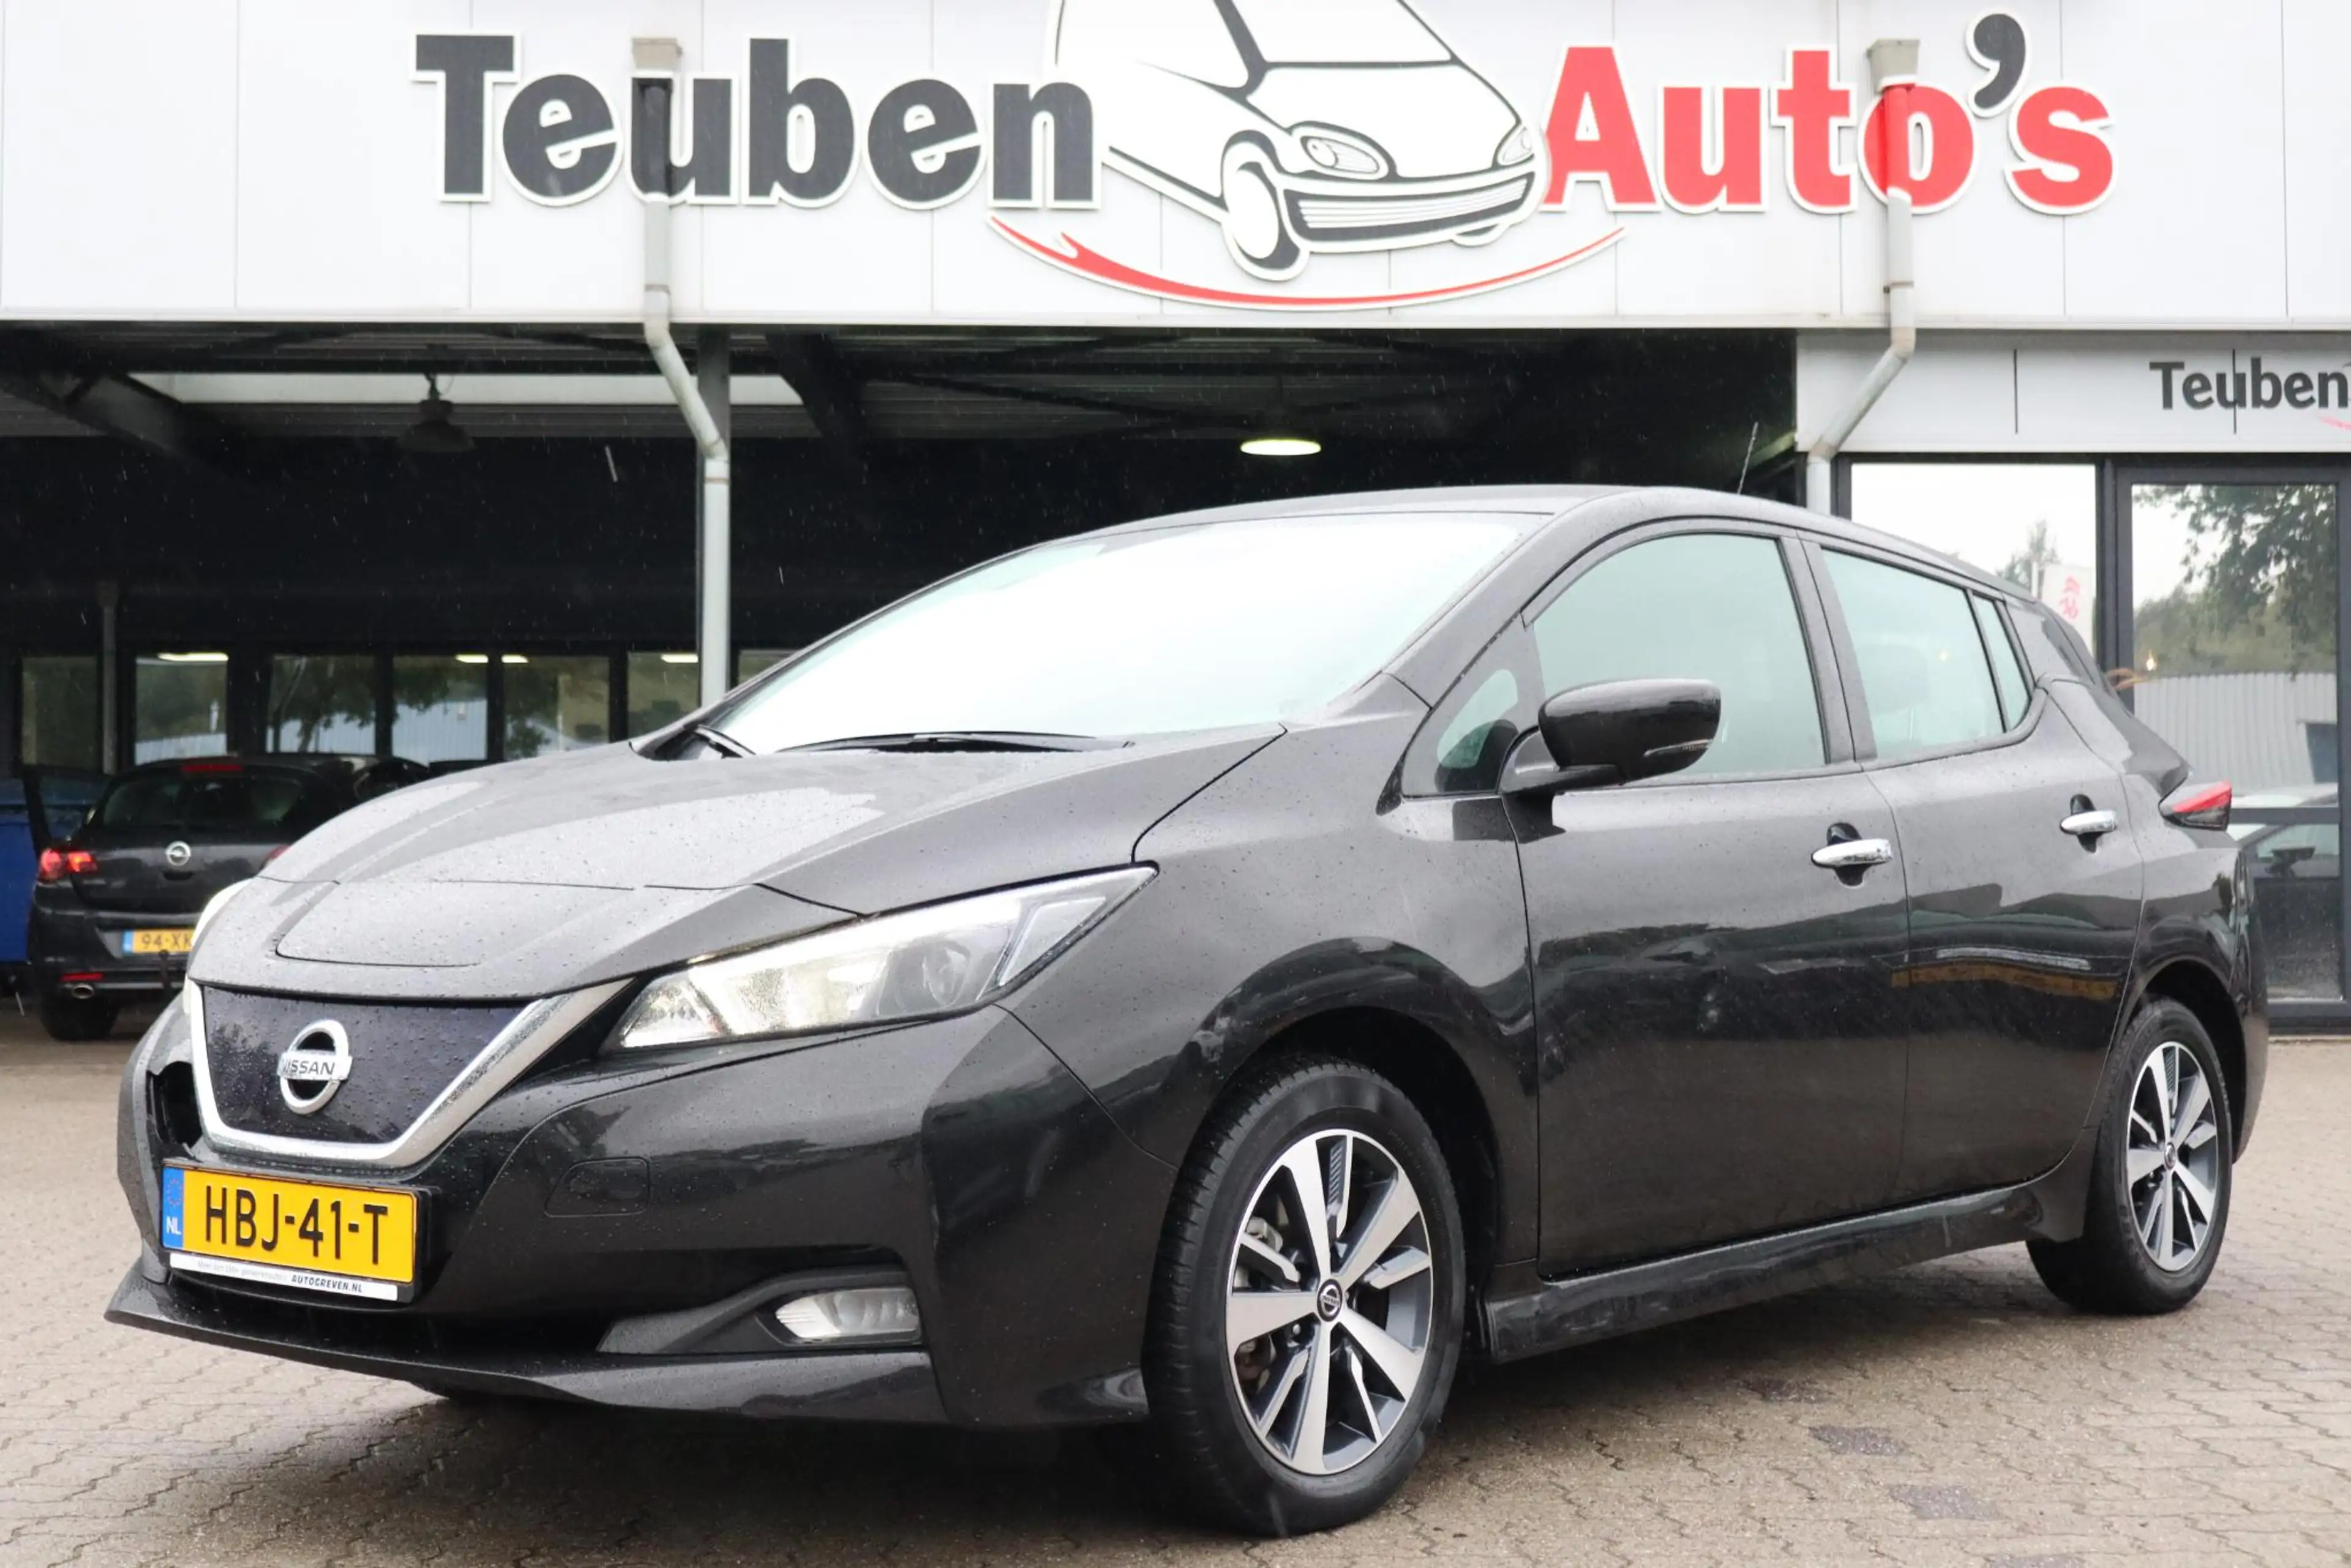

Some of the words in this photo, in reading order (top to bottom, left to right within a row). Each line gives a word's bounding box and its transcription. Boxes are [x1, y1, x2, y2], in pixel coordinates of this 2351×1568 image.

[414, 34, 1094, 203] Teuben
[1542, 13, 2113, 208] Auto's
[2148, 356, 2349, 410] Teuben
[166, 1215, 182, 1236] NL
[205, 1185, 388, 1266] HBJ-41-T
